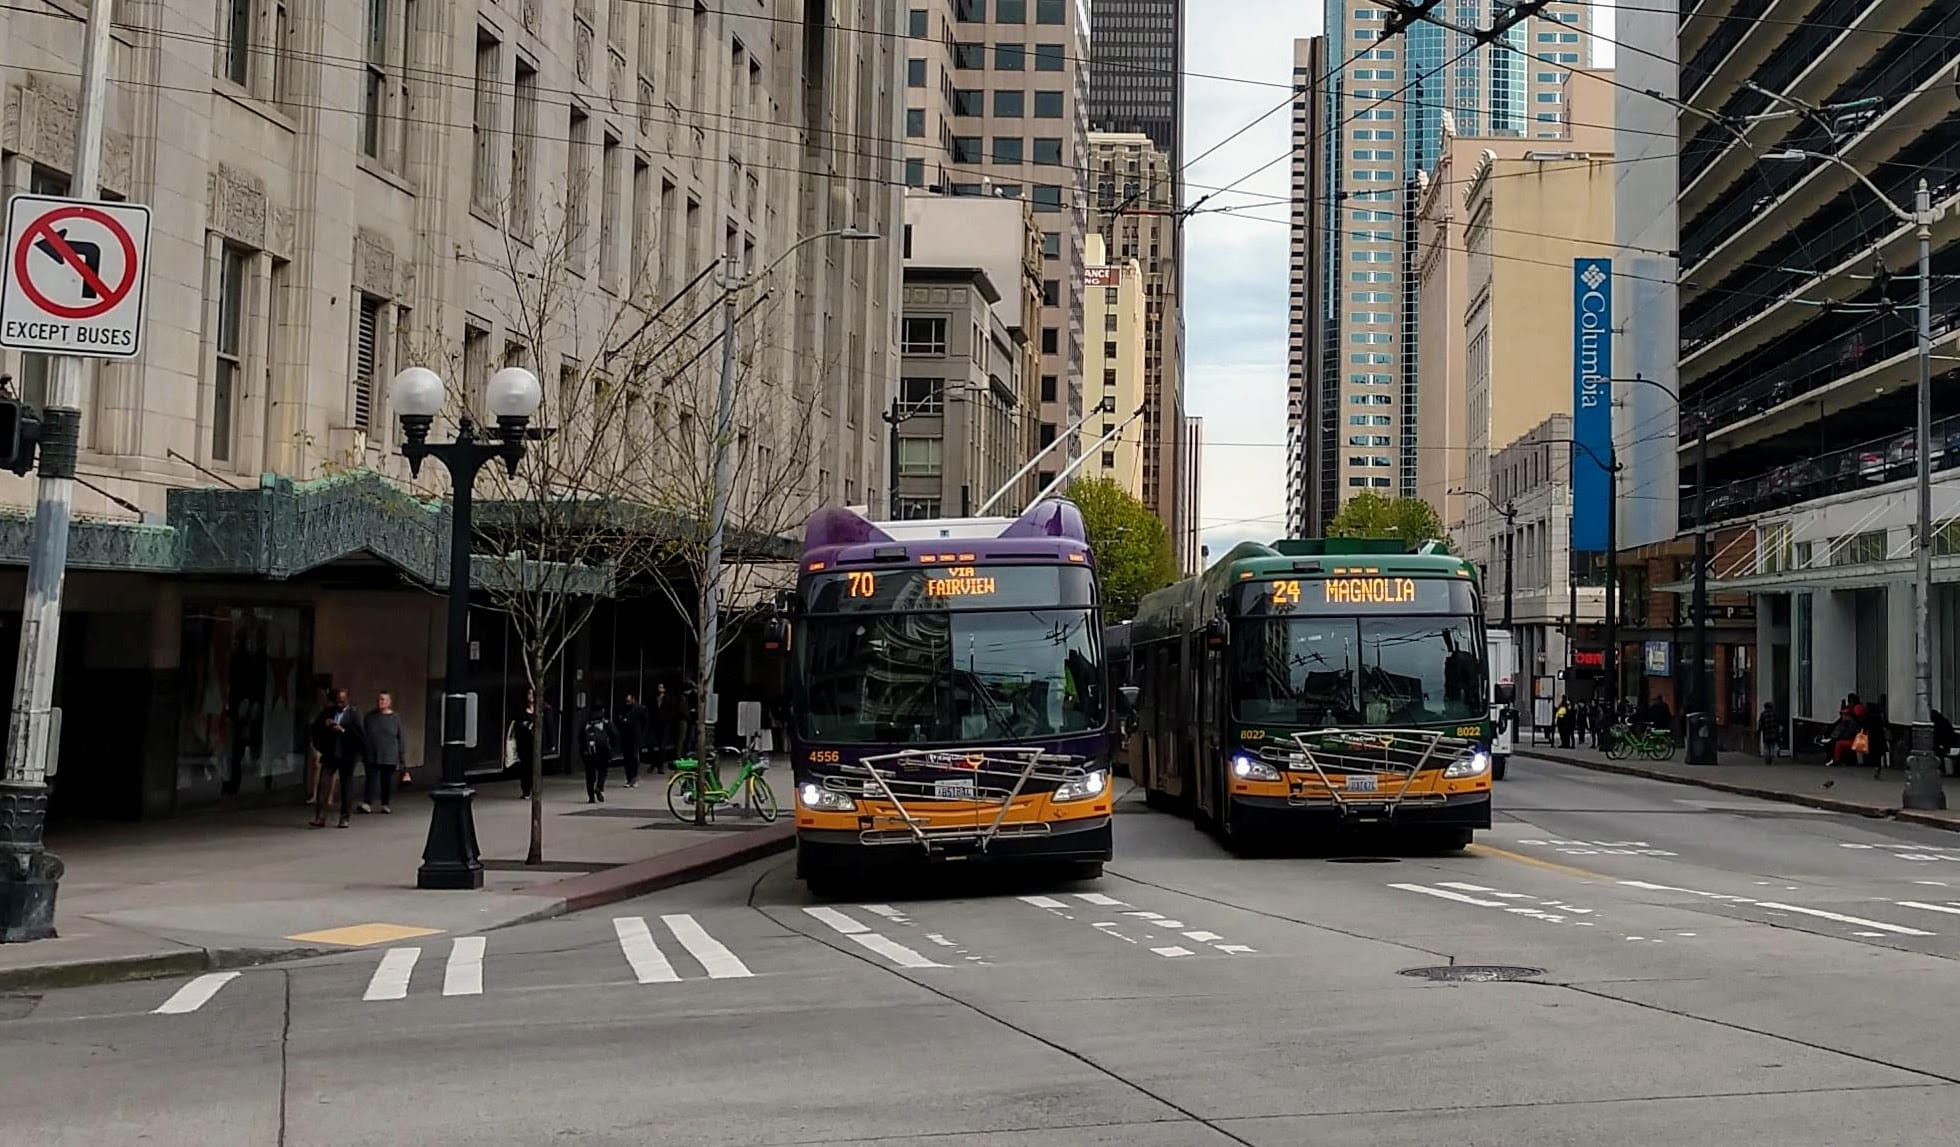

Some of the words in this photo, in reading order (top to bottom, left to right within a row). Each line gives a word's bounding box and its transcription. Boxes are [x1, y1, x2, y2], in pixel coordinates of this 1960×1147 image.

[6, 321, 70, 341] EXCEPT
[77, 326, 131, 346] BUSES
[1581, 291, 1606, 409] Columbia
[948, 567, 975, 577] VIA
[848, 571, 874, 597] 70
[928, 577, 995, 596] FAIRVIEW
[1272, 580, 1301, 604] 24
[1325, 578, 1416, 603] MAGNOLIA
[1727, 606, 1734, 618] P
[1240, 729, 1266, 740] 8022
[1456, 726, 1481, 737] 8022
[808, 750, 840, 762] 4556
